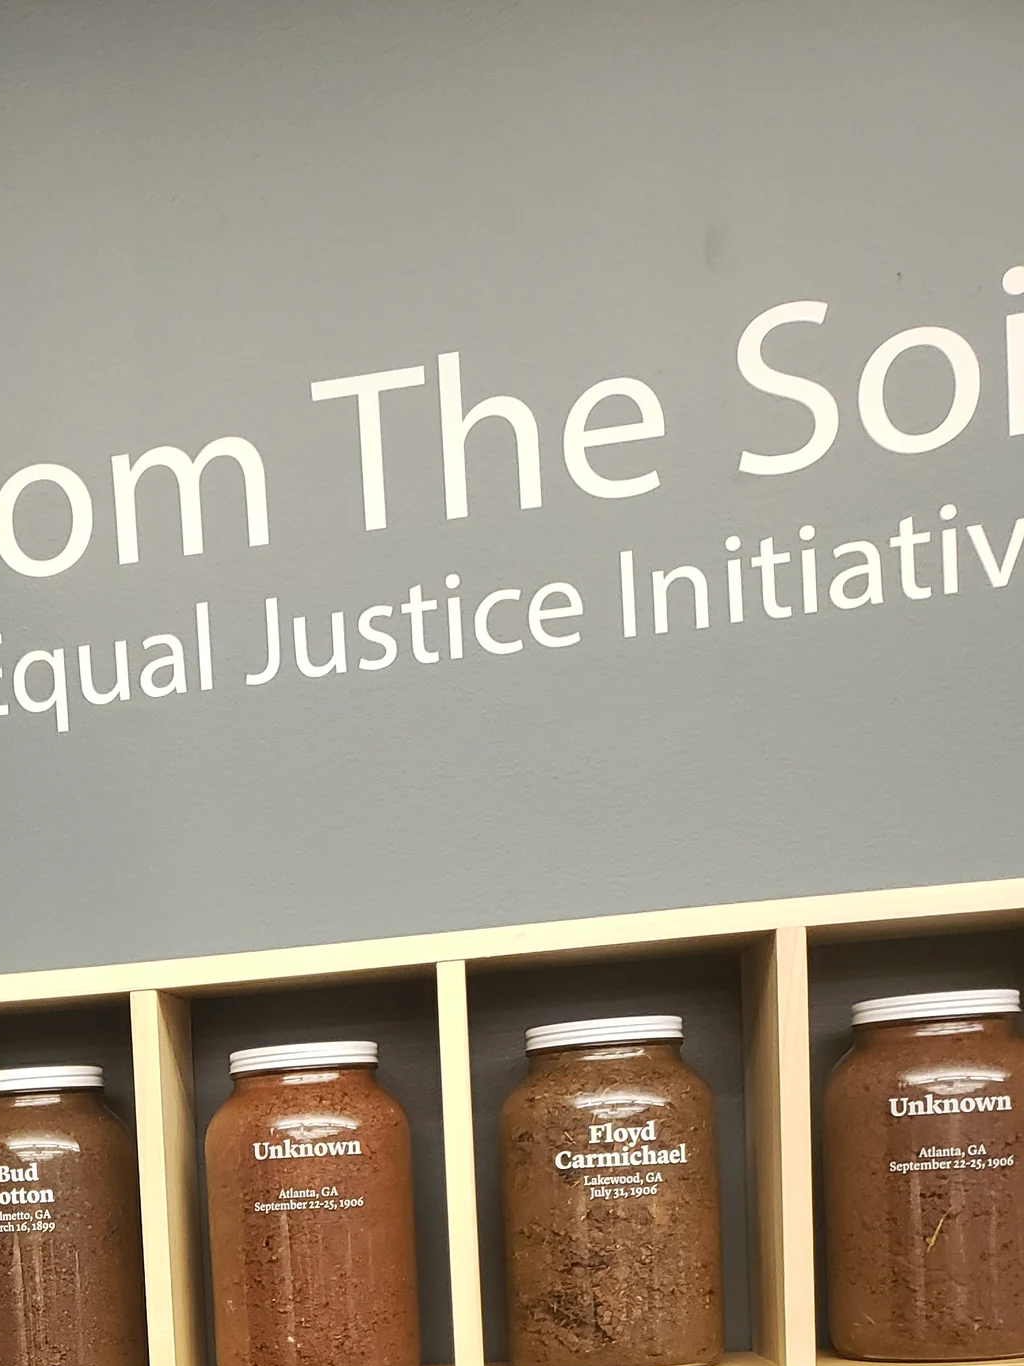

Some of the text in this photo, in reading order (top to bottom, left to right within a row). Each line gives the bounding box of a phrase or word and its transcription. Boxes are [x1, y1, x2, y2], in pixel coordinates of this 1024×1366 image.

[310, 351, 666, 531] The
[737, 265, 1024, 476] Soi
[245, 574, 584, 687] Justice
[620, 504, 1024, 638] Initiativ
[889, 1094, 1012, 1116] Unknown
[589, 1121, 657, 1147] Floyd
[253, 1139, 362, 1160] Unknown
[555, 1143, 687, 1172] Carmichael
[919, 1144, 986, 1158] Atlanta, GA
[890, 1155, 1013, 1174] September 22-25, 1906
[584, 1172, 663, 1185] Lakewood, GA
[279, 1186, 338, 1199] Atlanta, GA
[590, 1184, 657, 1200] July 31, 1906
[255, 1197, 363, 1213] September 22-25, 1906
[35, 1209, 51, 1219] GA
[16, 1222, 30, 1233] 16,
[32, 1221, 55, 1232] 1899
